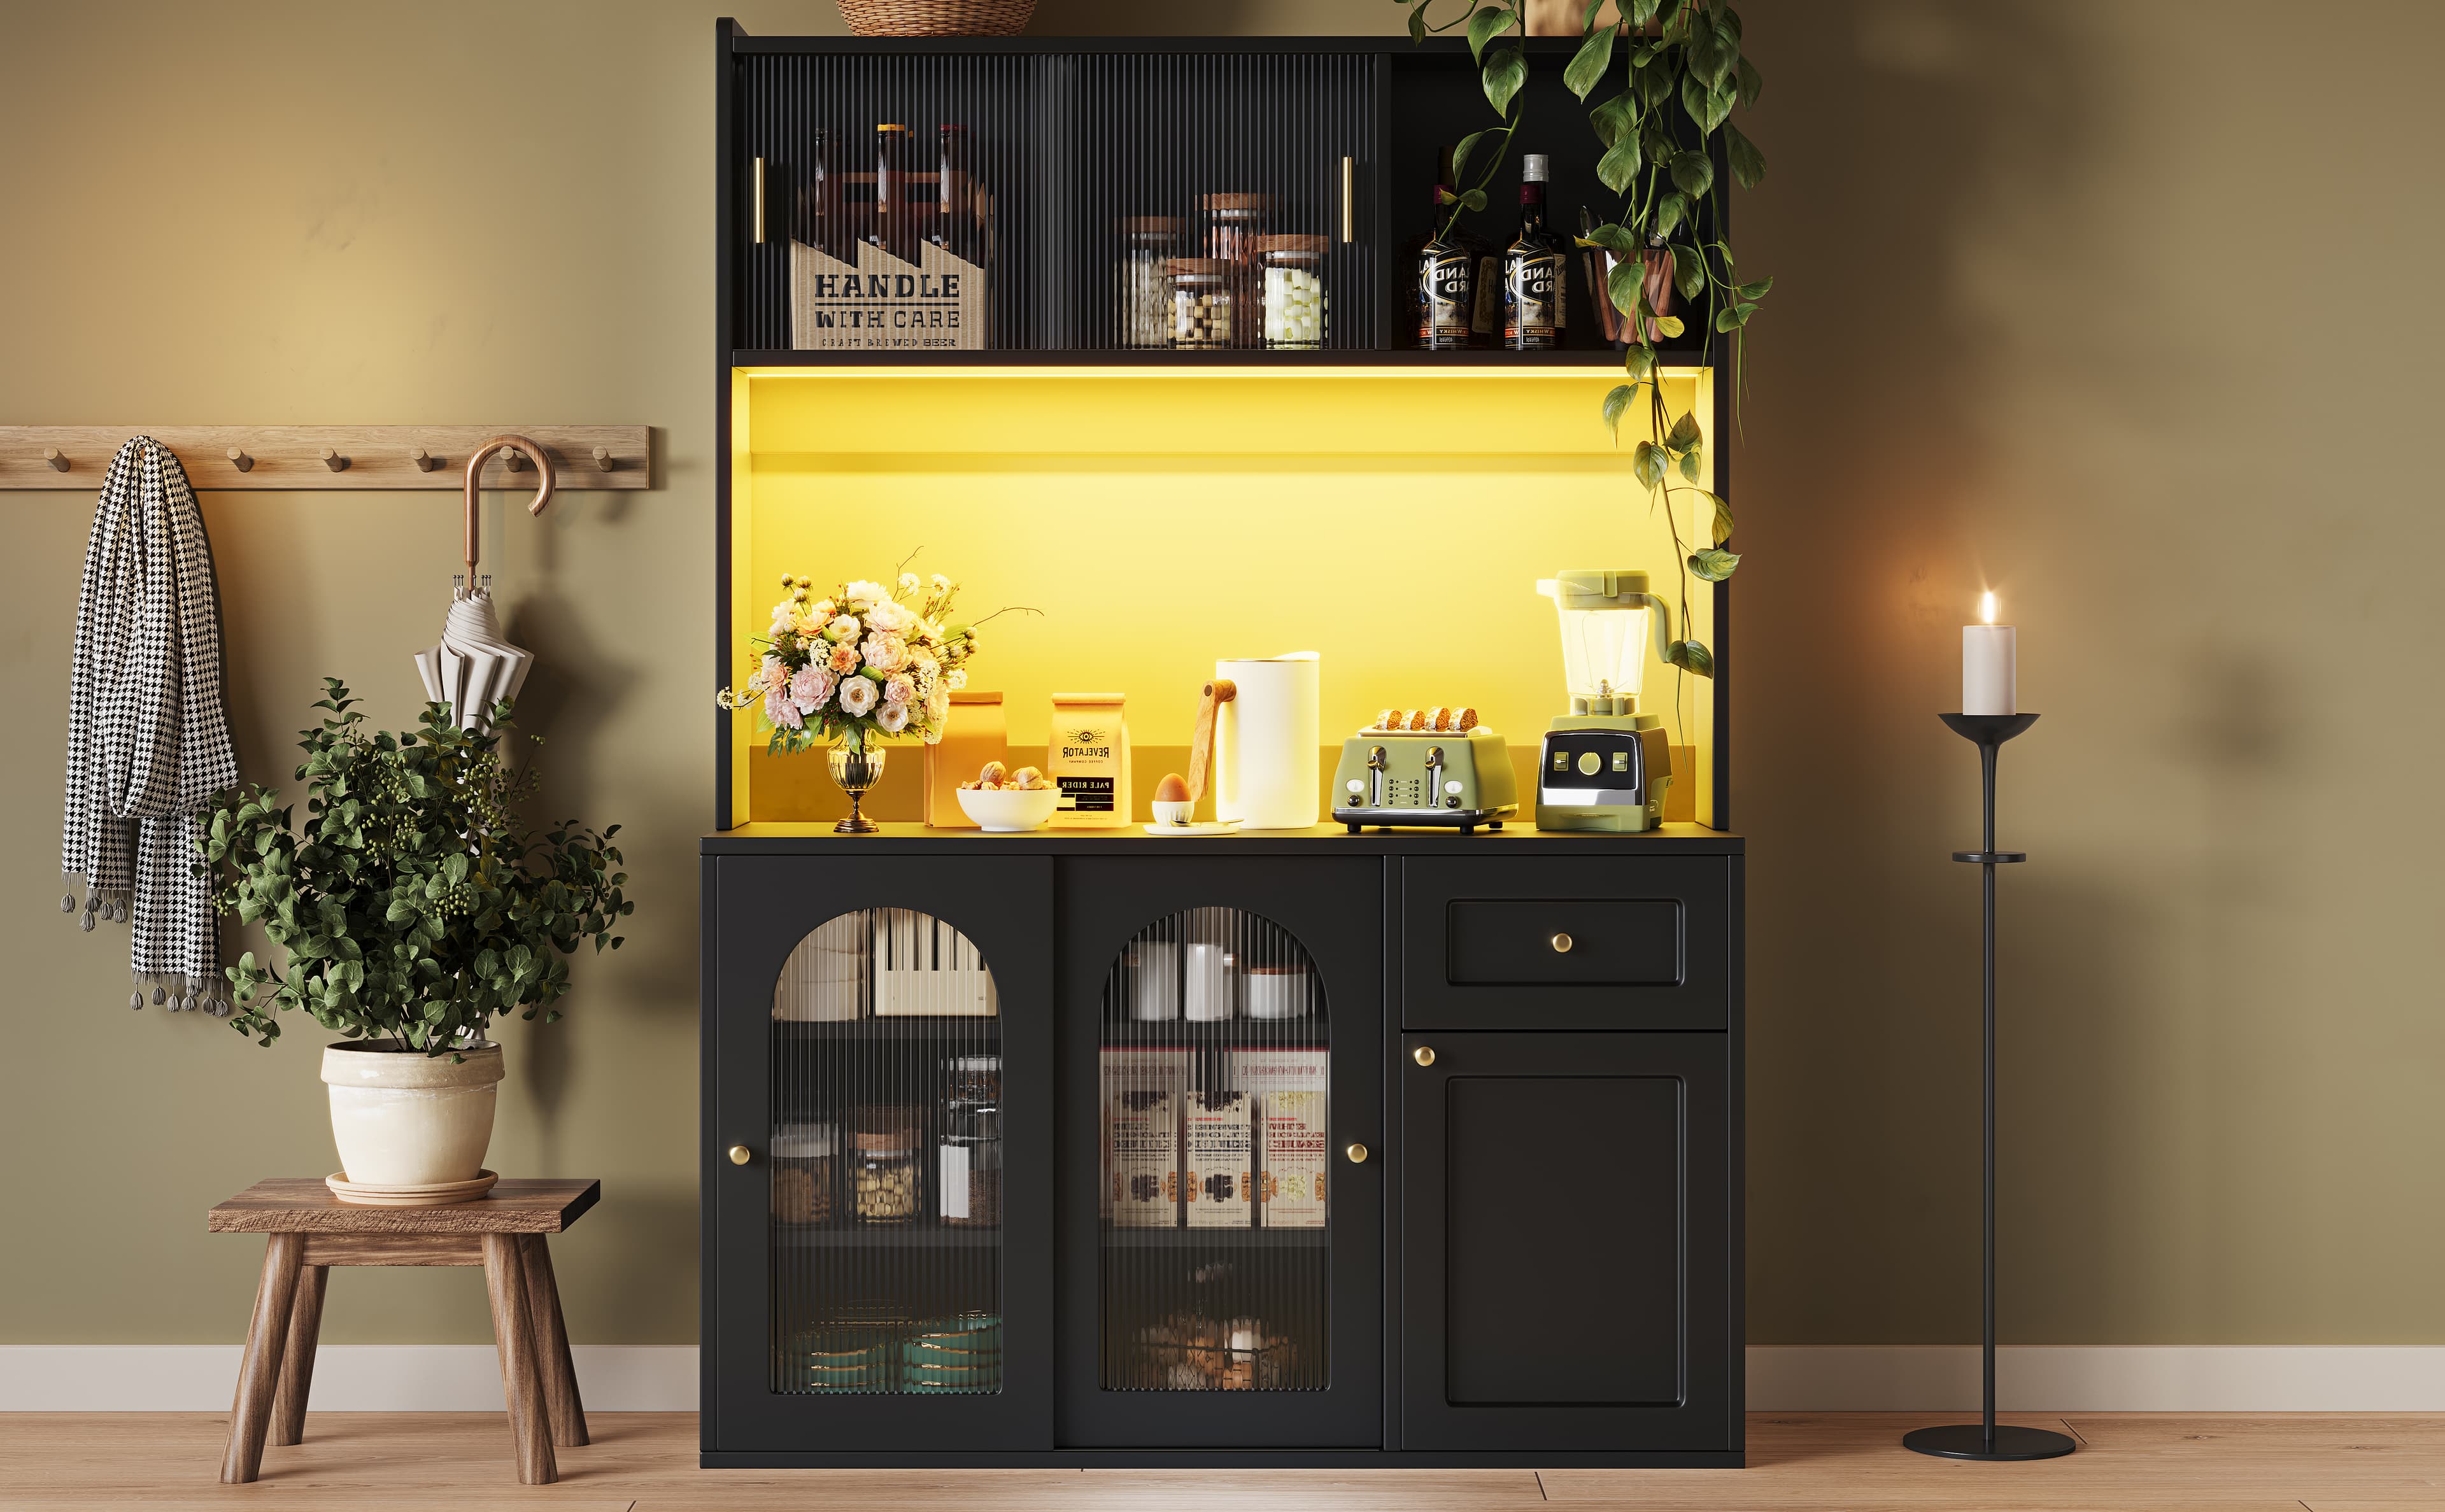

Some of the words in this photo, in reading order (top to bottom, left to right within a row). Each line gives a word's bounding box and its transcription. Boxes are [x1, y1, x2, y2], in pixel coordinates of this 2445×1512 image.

[815, 274, 959, 297] HANDLE
[815, 311, 884, 328] WITH
[894, 311, 959, 328] CARE
